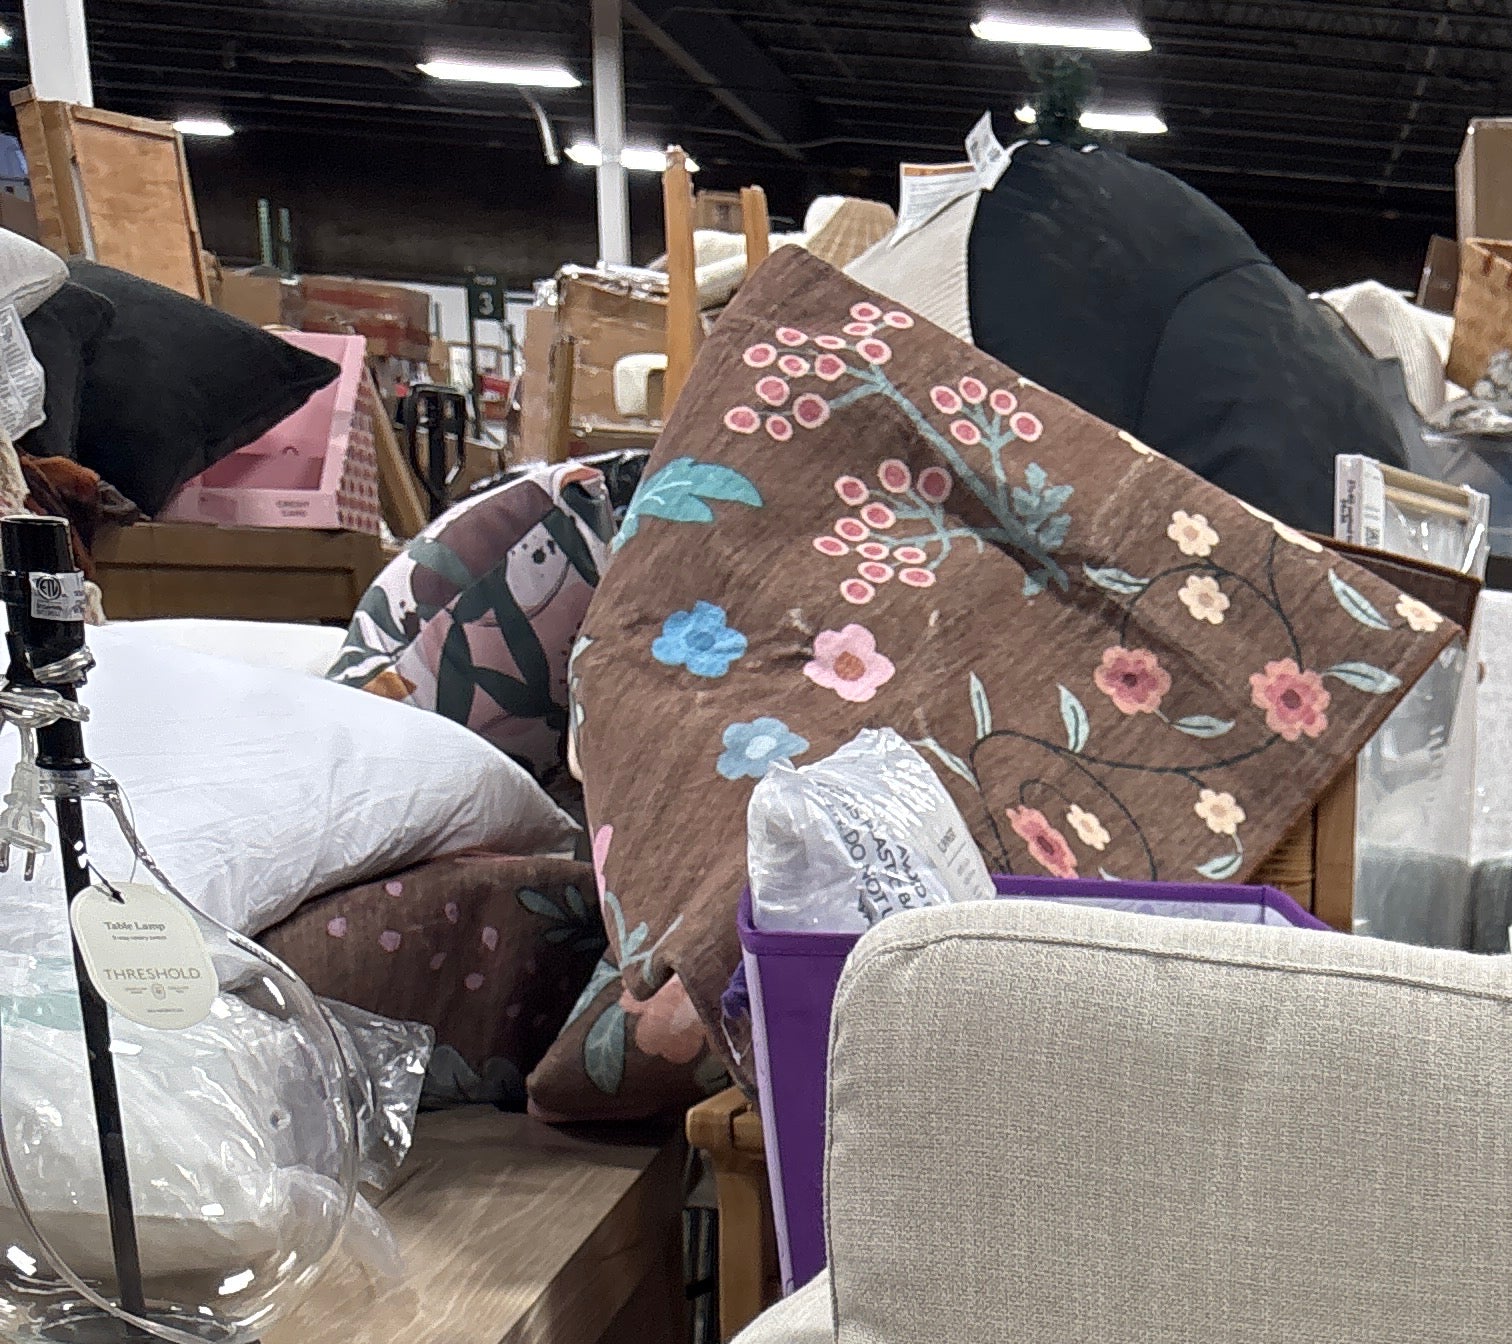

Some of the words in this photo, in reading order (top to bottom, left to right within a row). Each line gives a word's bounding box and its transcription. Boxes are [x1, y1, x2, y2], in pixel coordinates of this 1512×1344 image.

[478, 291, 494, 315] 3
[844, 829, 866, 861] DO
[104, 922, 133, 930] Table
[134, 922, 166, 932] Lamp
[103, 967, 201, 980] THRESHOLD
